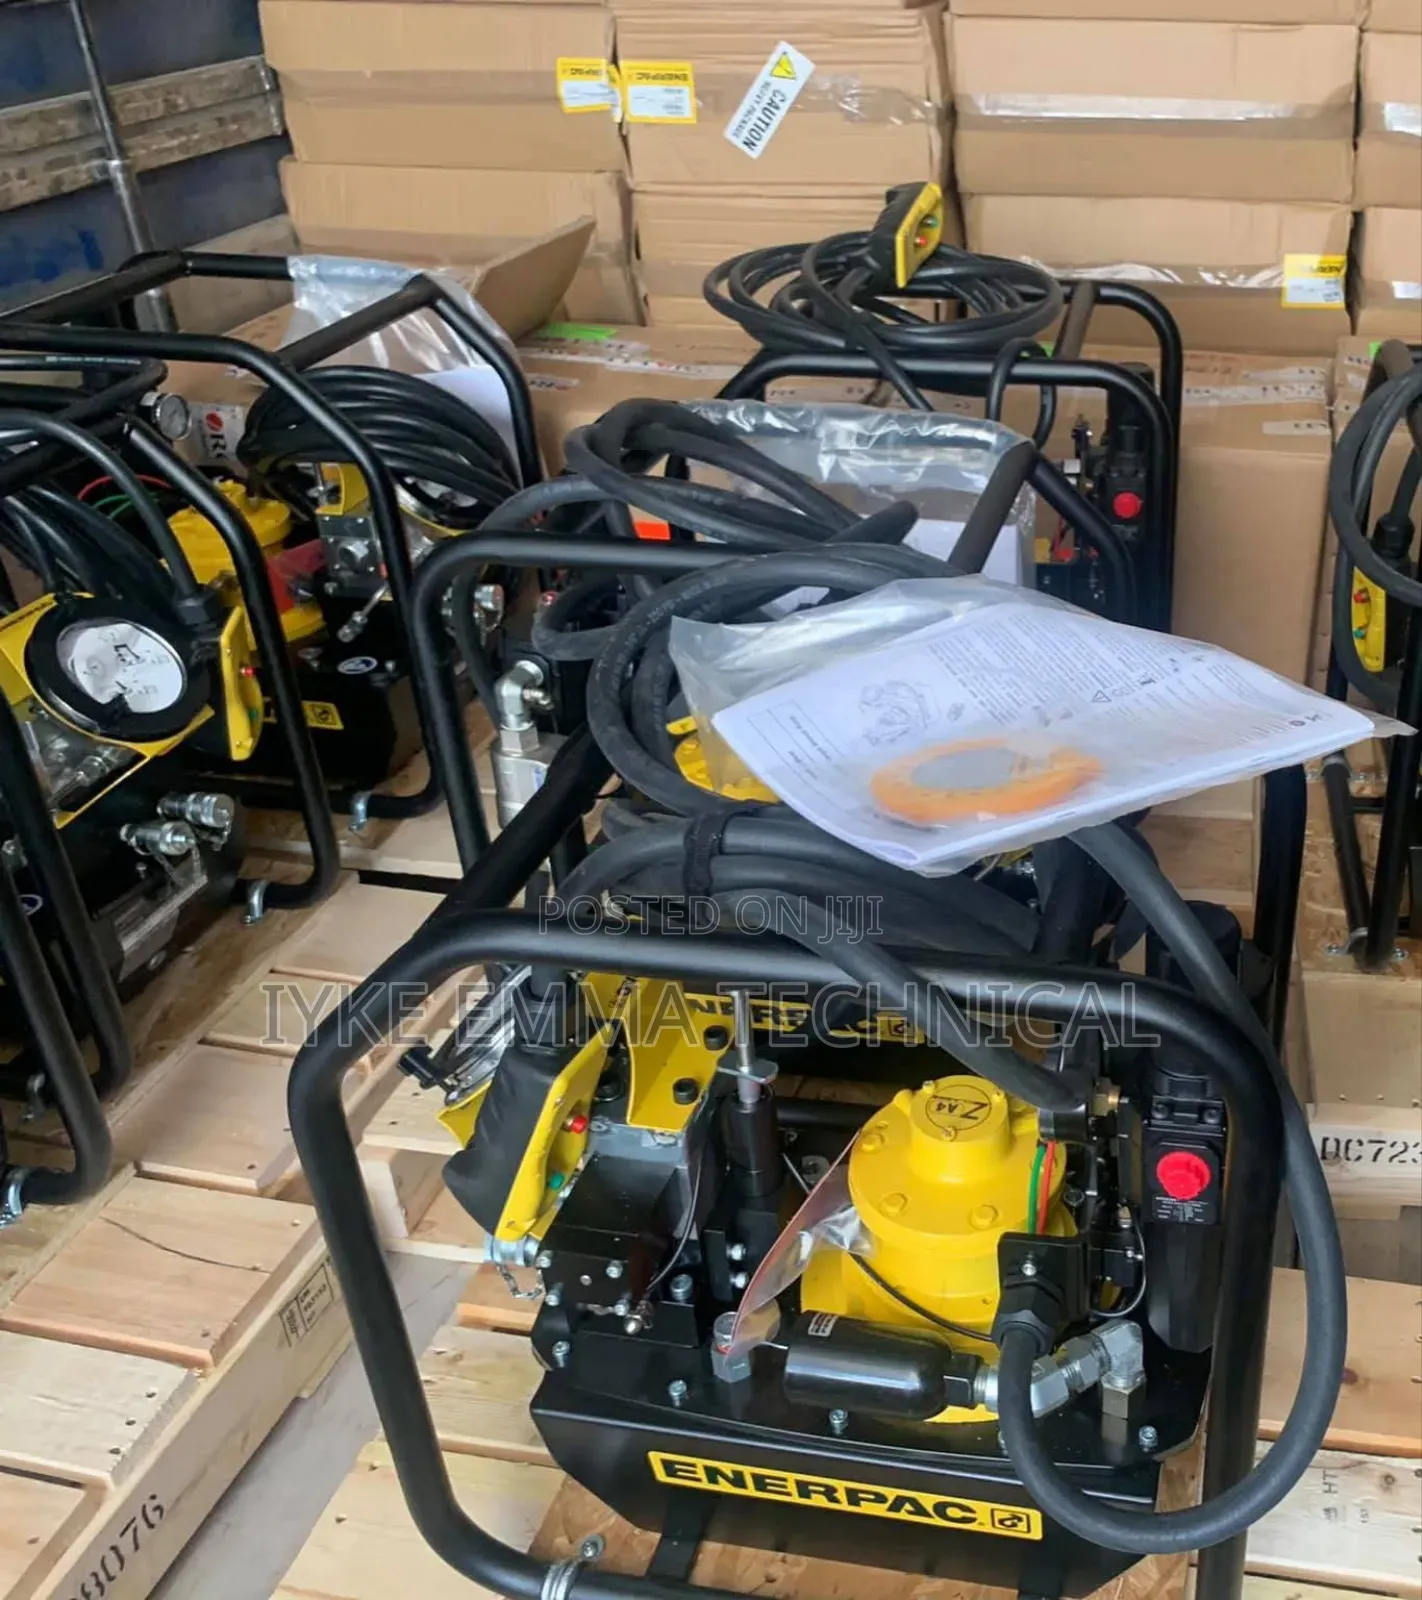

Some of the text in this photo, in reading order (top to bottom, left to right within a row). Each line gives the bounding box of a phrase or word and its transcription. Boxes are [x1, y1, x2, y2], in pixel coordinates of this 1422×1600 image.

[743, 89, 786, 151] CAUTION
[661, 1459, 980, 1525] ENERPAC
[1322, 1470, 1339, 1494] HT
